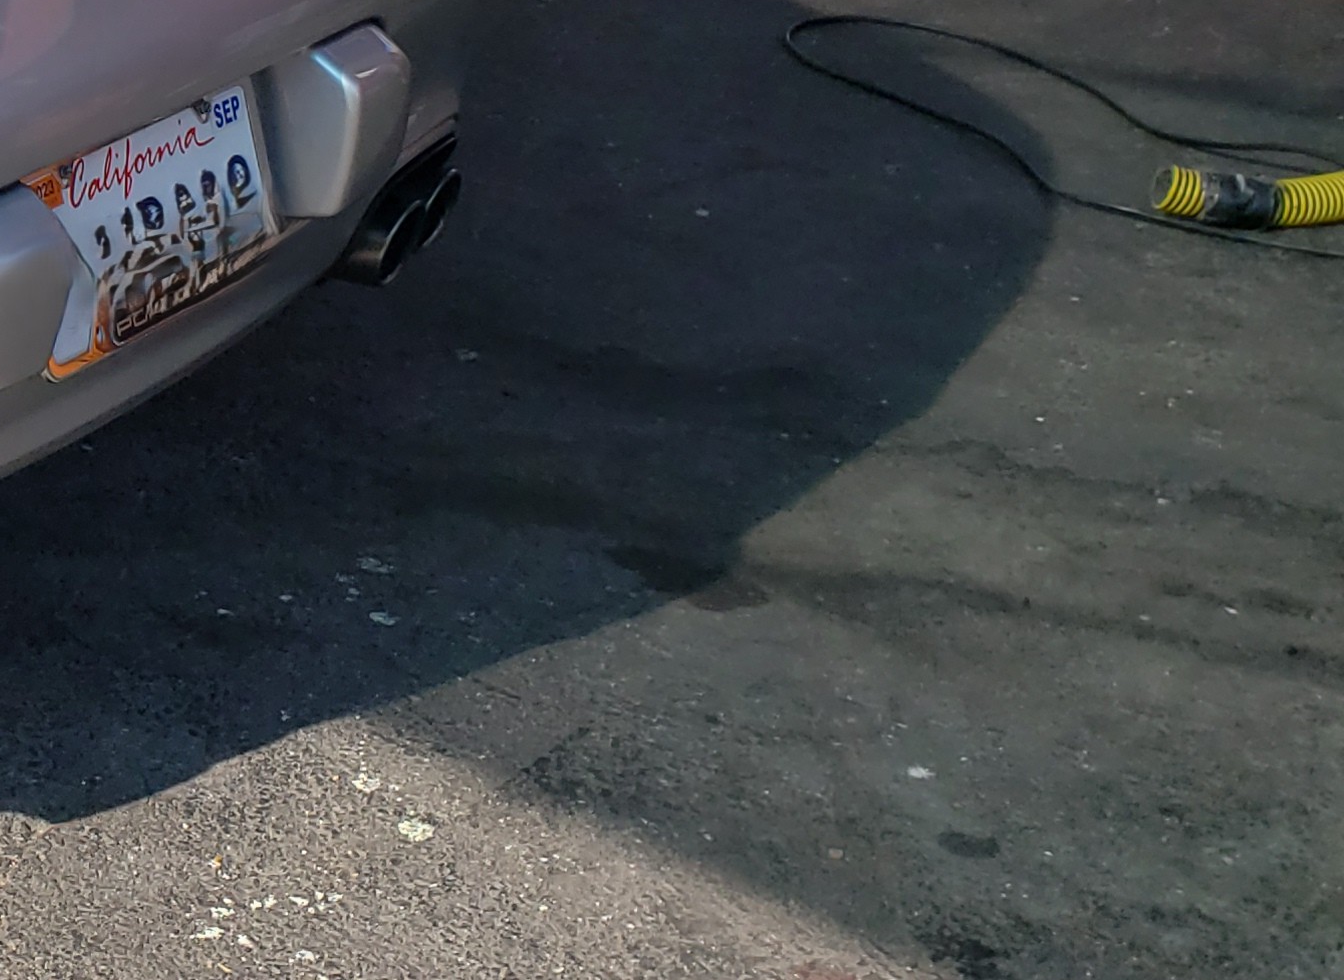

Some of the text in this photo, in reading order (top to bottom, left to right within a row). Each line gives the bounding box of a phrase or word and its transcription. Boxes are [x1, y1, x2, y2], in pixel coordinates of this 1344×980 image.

[213, 95, 240, 129] SEP
[67, 119, 215, 209] California
[35, 179, 55, 200] 023
